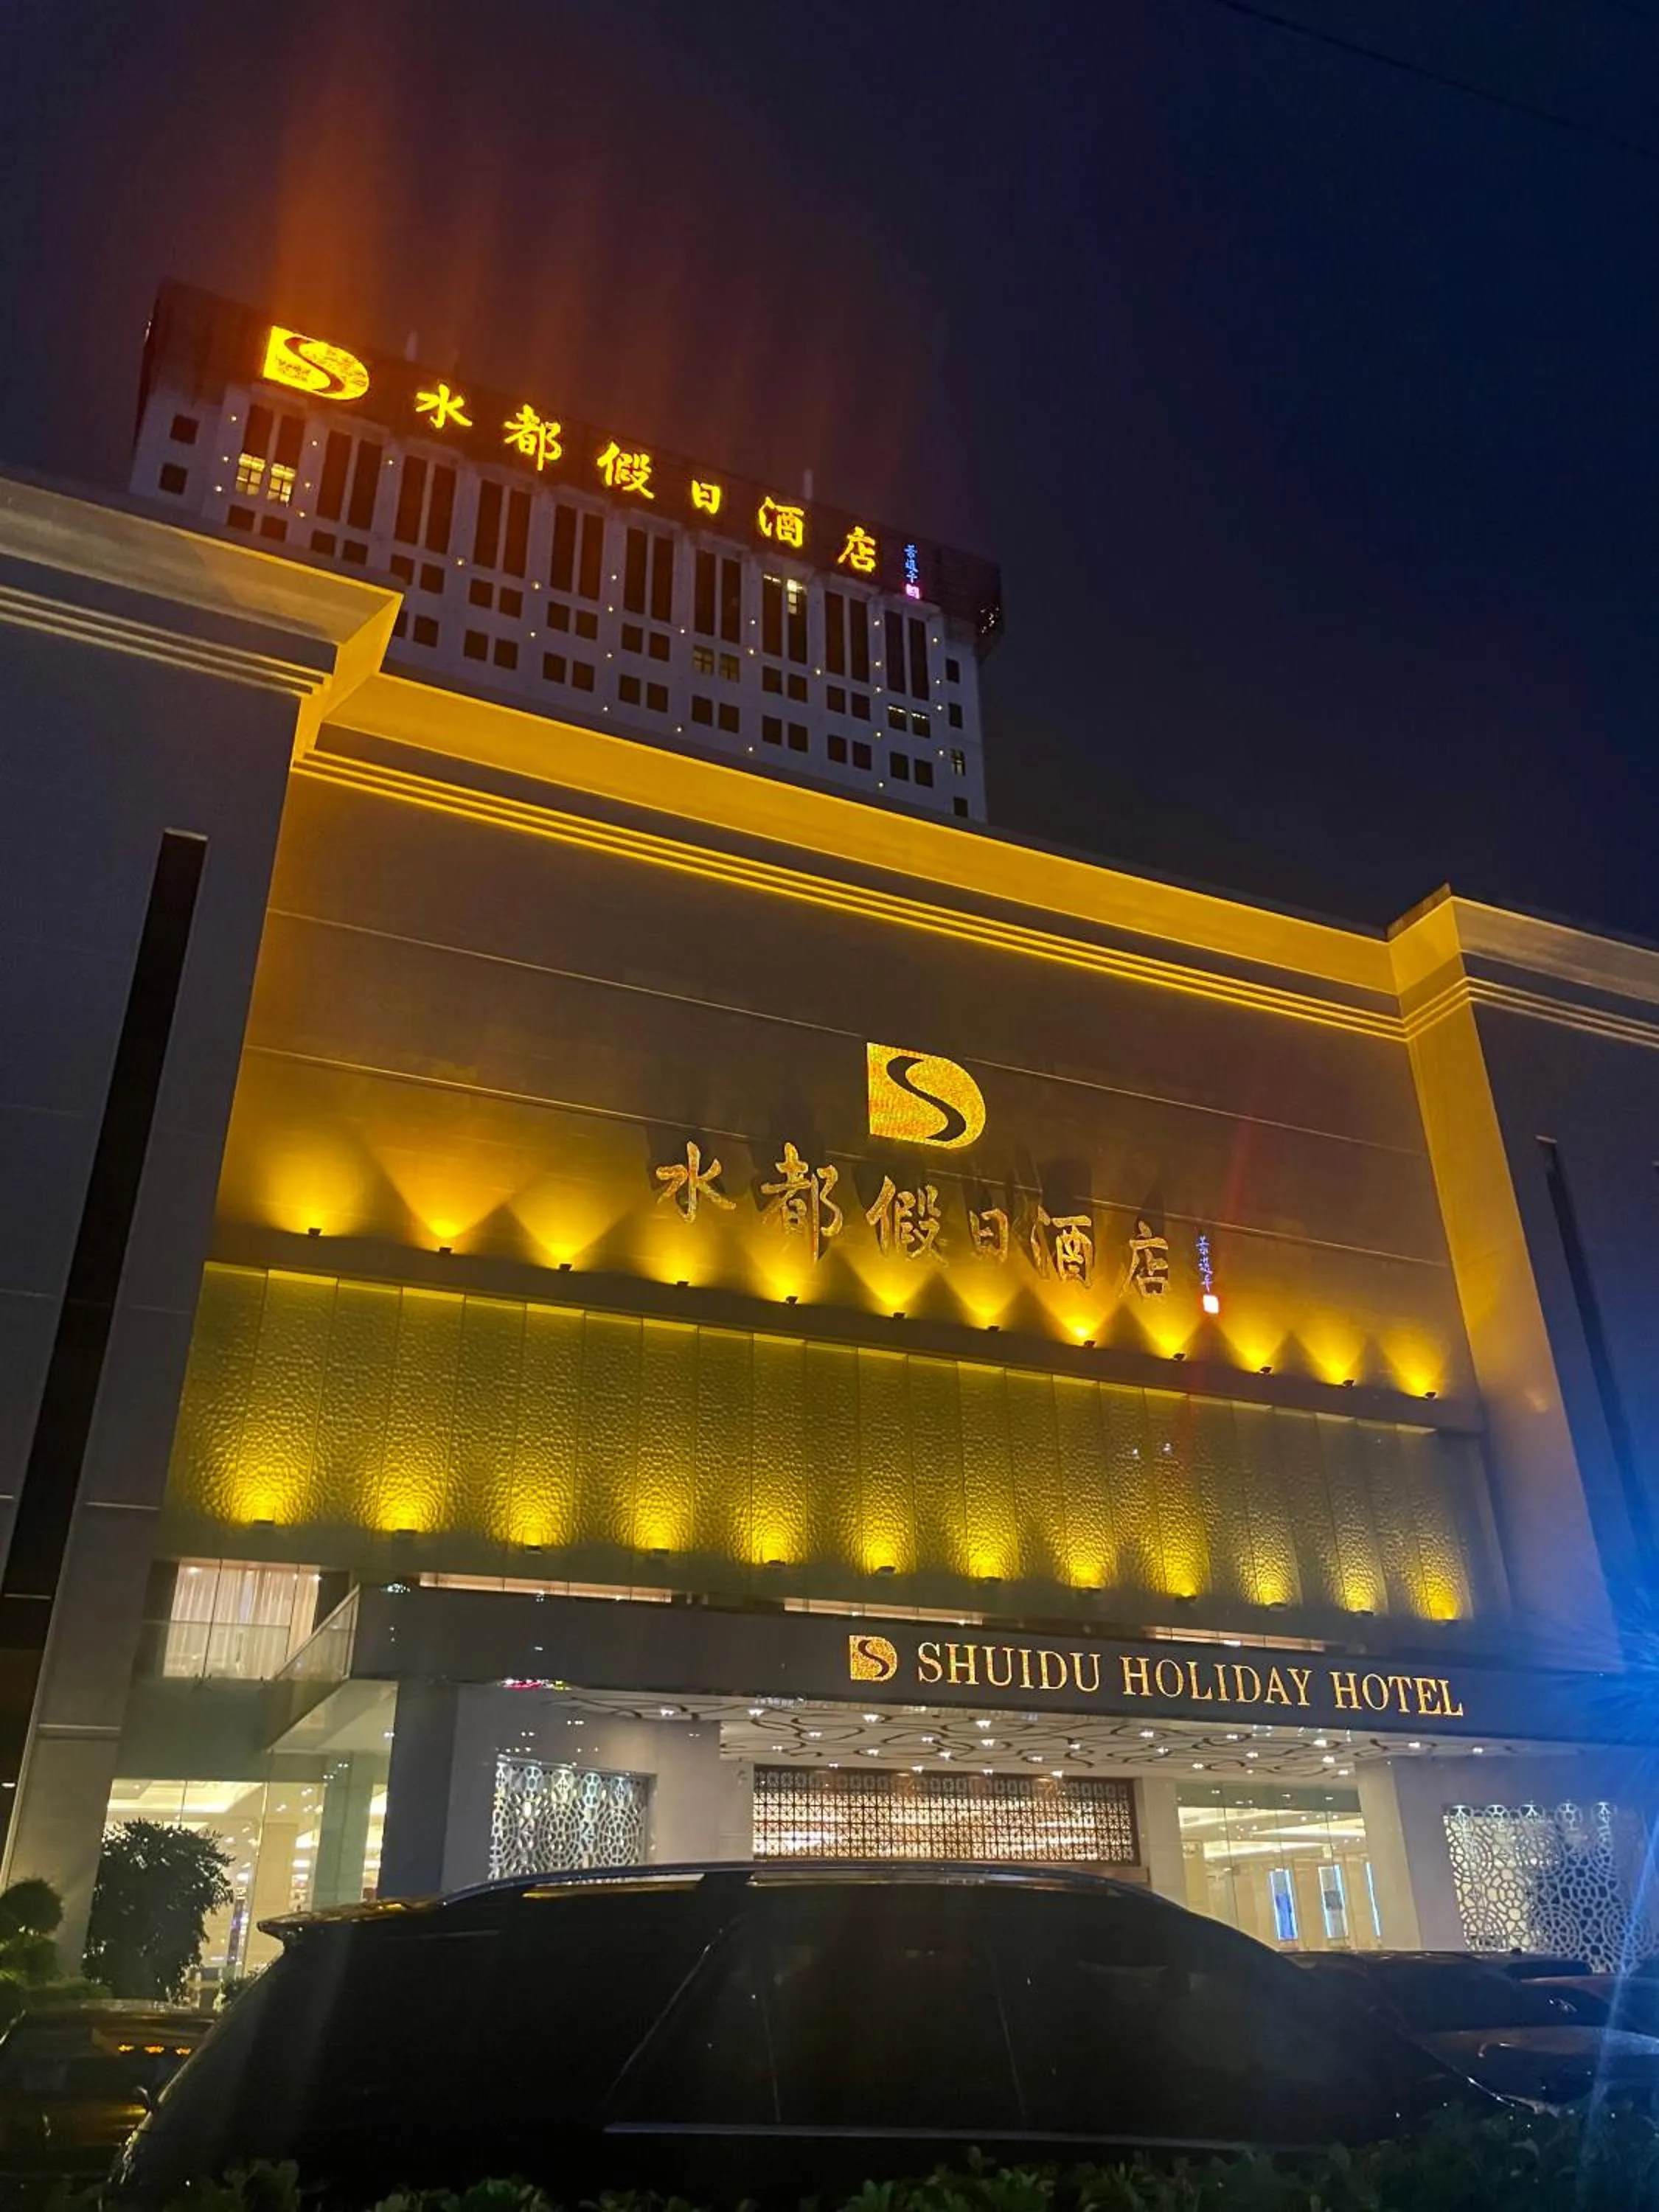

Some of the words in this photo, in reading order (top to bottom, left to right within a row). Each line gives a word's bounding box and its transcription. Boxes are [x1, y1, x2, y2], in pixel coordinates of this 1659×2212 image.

[415, 383, 877, 574] 水都假日酒店
[655, 1140, 1171, 1302] 水都假日酒店
[917, 1641, 1101, 1692] SHUIDU
[1119, 1655, 1312, 1705] HOLIDAY
[1329, 1671, 1464, 1717] HOTEL
